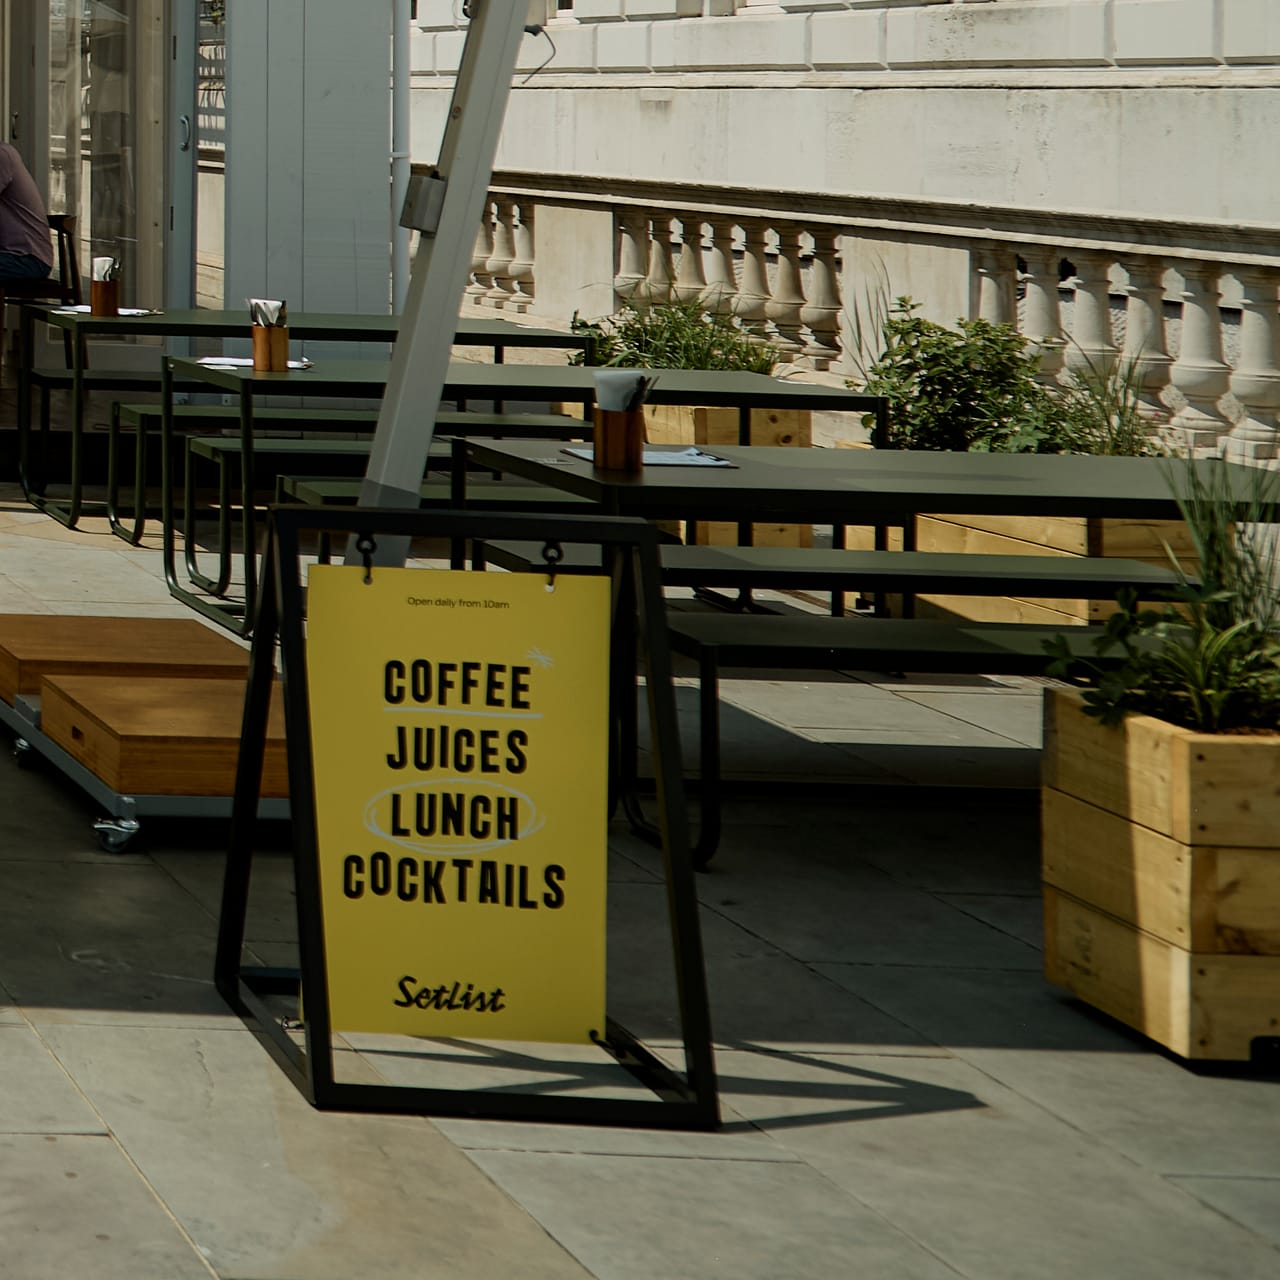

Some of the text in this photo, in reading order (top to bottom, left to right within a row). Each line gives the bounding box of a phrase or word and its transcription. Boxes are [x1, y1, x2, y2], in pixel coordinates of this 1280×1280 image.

[407, 596, 510, 609] Open daily from 10am
[384, 658, 531, 710] COFFEE
[386, 725, 529, 775] JUICES
[391, 792, 519, 841] LUNCH
[343, 851, 566, 910] COCKTAILS
